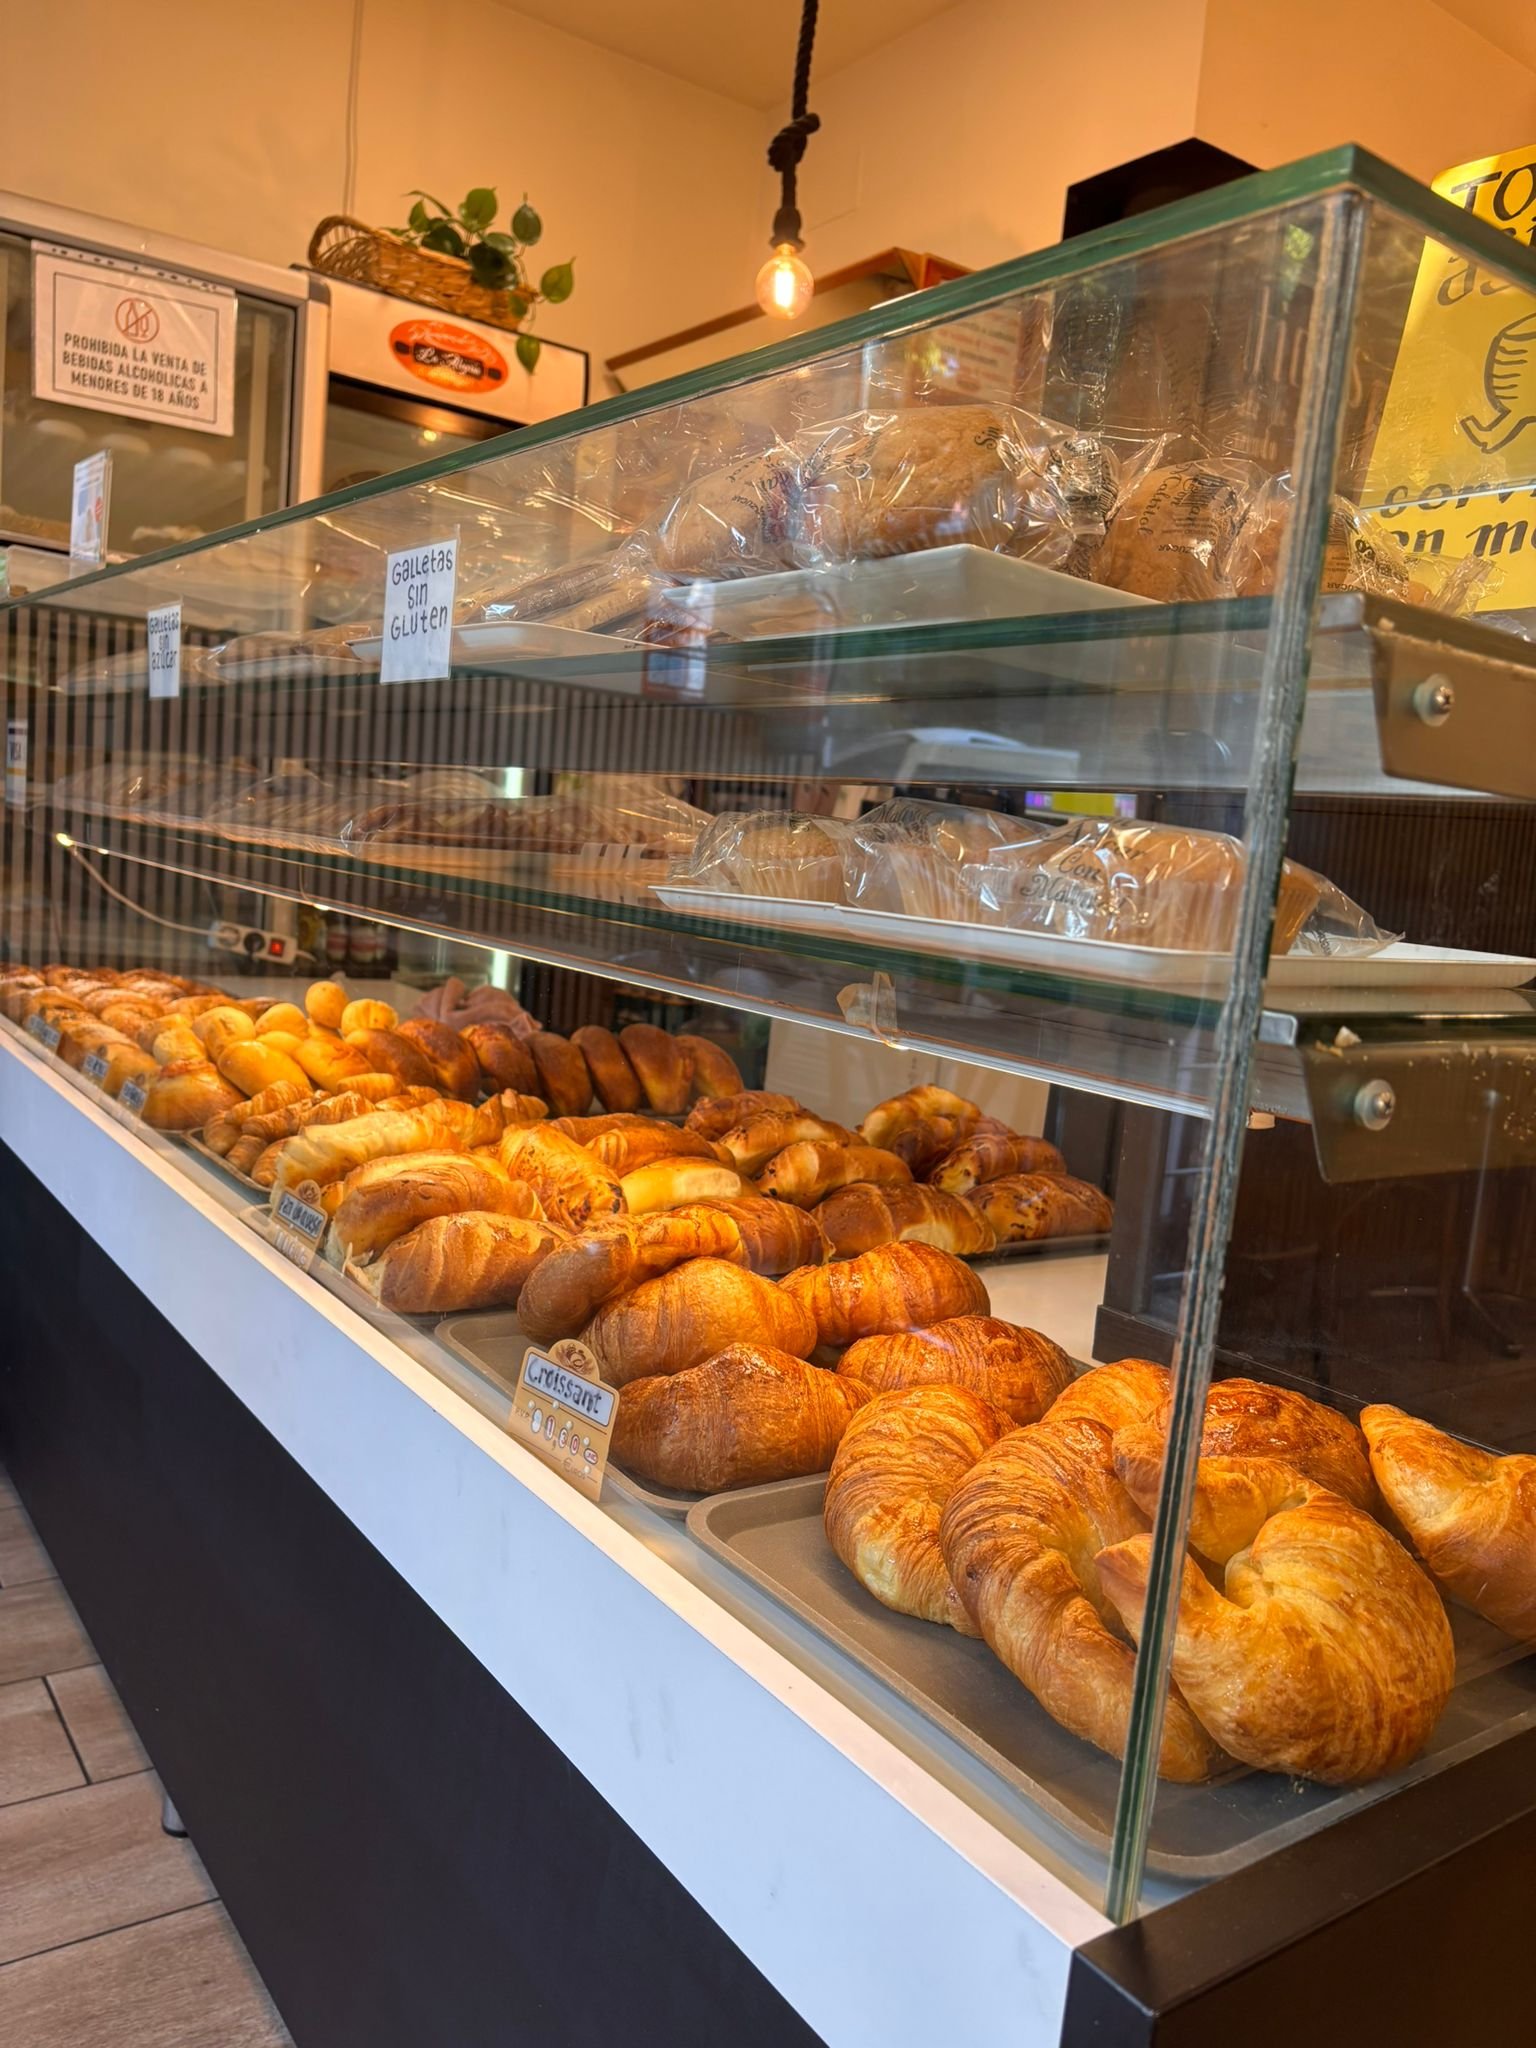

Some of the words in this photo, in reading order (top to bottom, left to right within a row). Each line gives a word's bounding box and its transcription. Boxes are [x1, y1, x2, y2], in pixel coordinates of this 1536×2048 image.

[62, 351, 113, 374] BEBIDAS
[117, 361, 196, 391] ALCOHOLICAS
[200, 379, 208, 394] A
[64, 332, 128, 357] PROHIBIDA
[132, 347, 148, 363] LA
[152, 352, 189, 372] VENTA
[192, 361, 208, 377] DE
[71, 371, 129, 395] MENORES
[133, 384, 148, 400] DE
[152, 387, 164, 402] 18
[168, 389, 200, 410] AÑOS
[1466, 520, 1536, 557] m
[527, 1358, 602, 1415] Croissant
